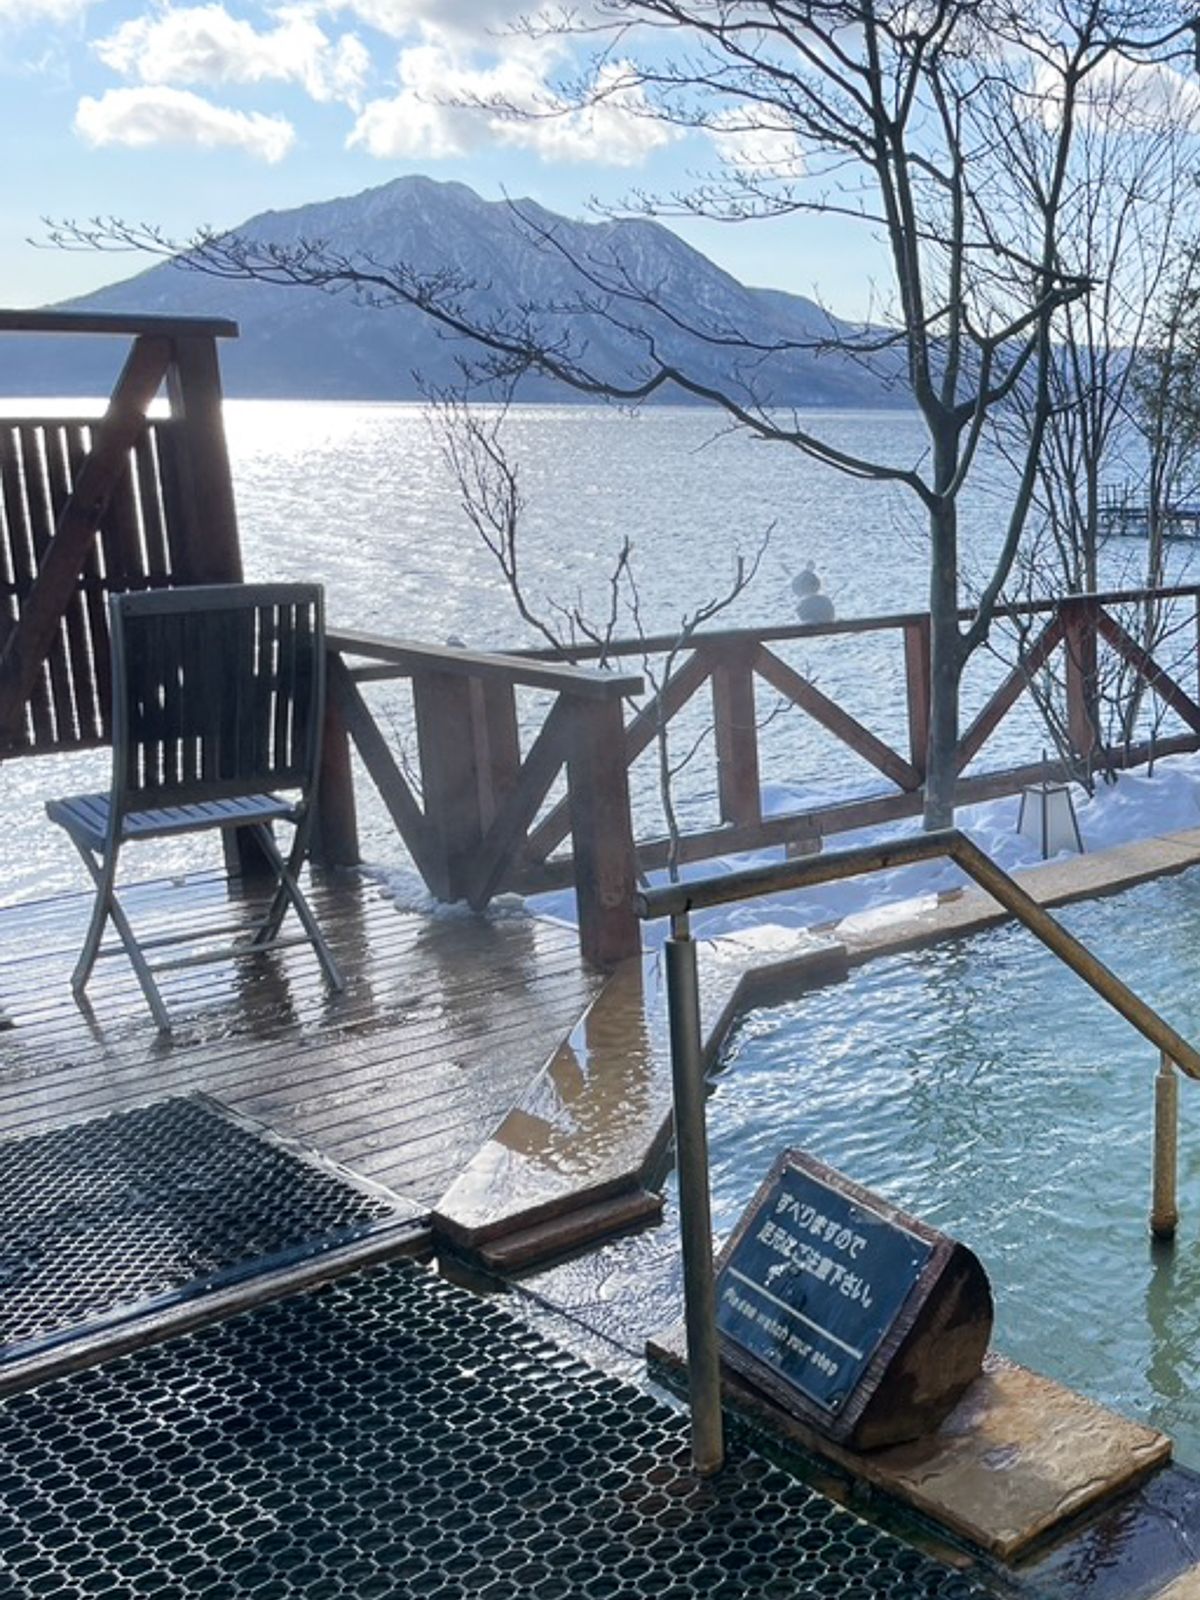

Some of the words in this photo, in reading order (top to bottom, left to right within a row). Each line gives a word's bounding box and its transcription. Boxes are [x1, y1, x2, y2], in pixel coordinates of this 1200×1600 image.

[776, 1192, 867, 1258] すべりますので
[757, 1310, 788, 1341] watch
[787, 1336, 813, 1358] your
[810, 1350, 838, 1377] step
